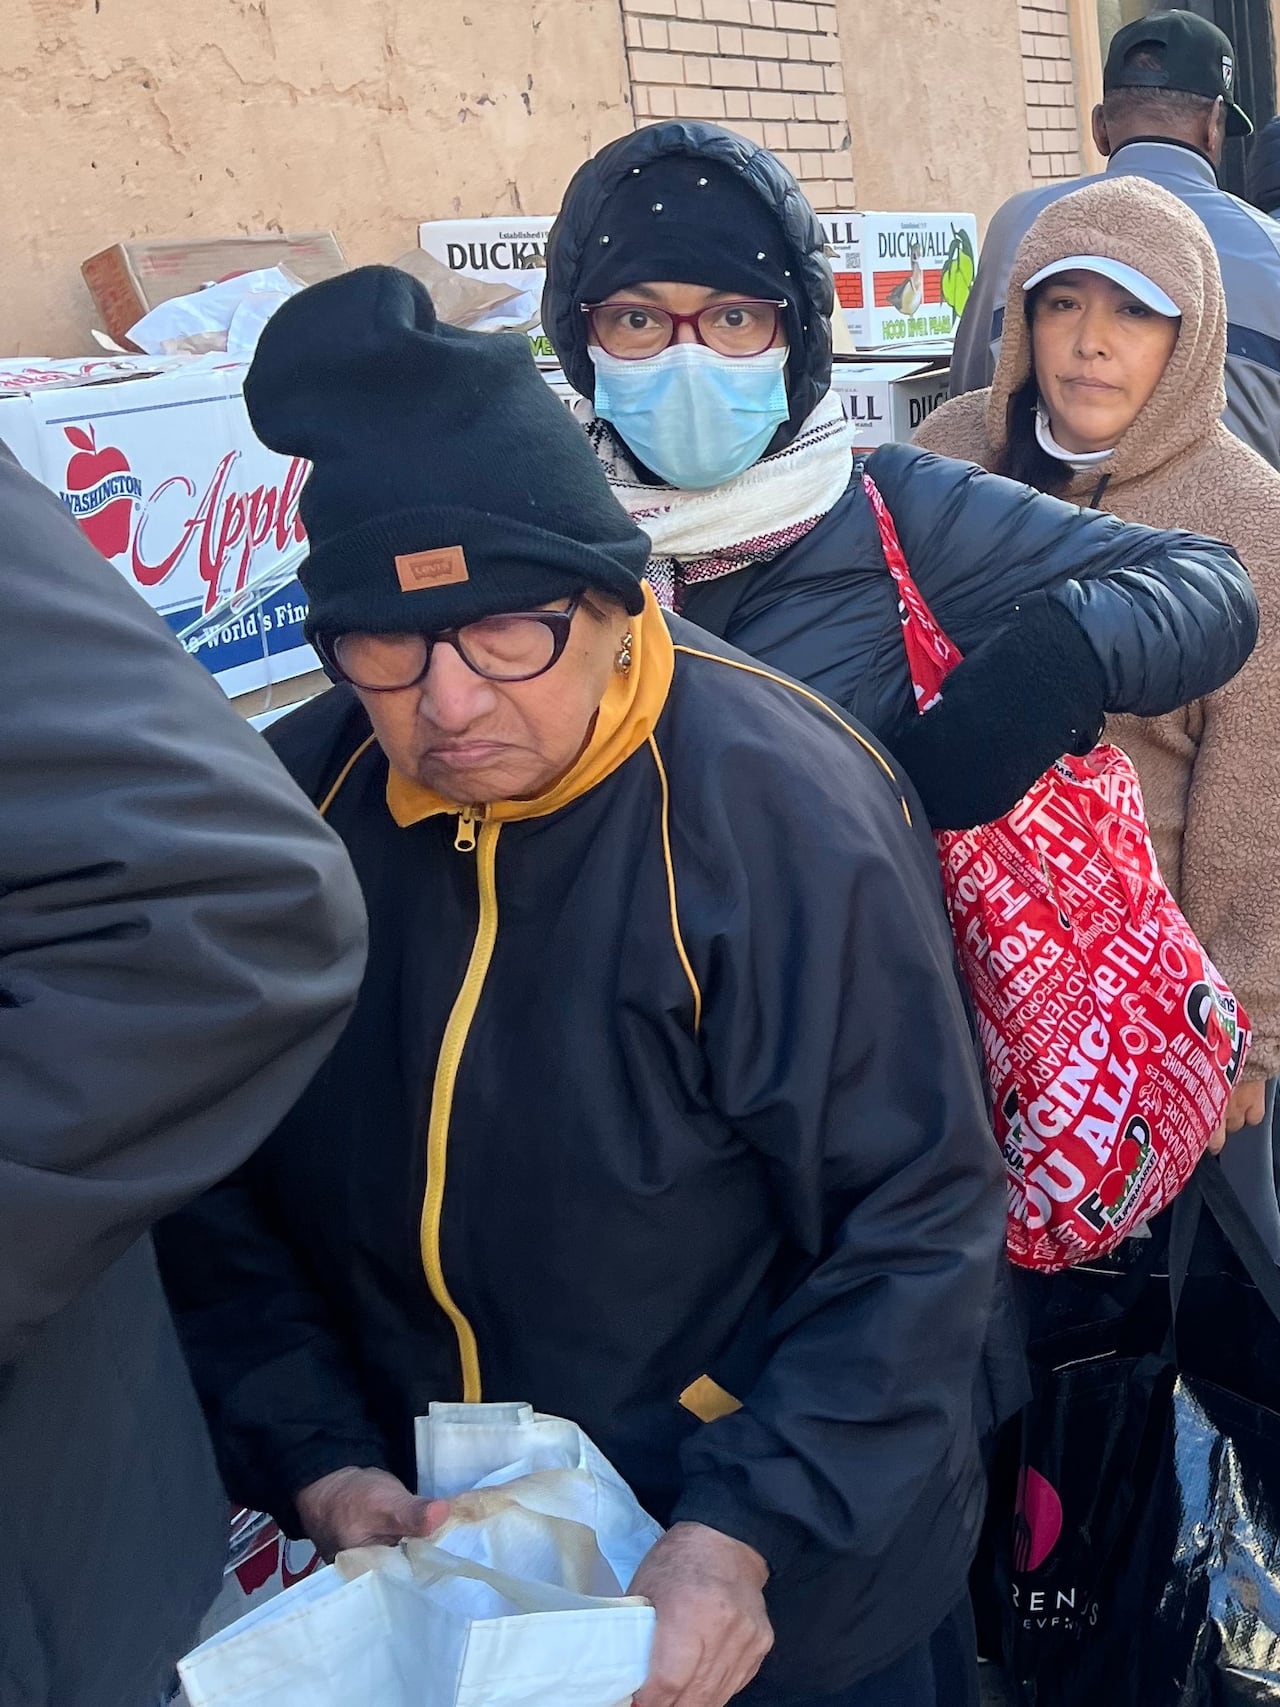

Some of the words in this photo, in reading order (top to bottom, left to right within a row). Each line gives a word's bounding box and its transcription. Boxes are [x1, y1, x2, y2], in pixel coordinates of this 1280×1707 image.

[1032, 997, 1095, 1090] CULINARY
[1161, 1051, 1198, 1096] SHOPPING
[1169, 1032, 1194, 1058] AN
[1144, 1063, 1178, 1095] PRICES
[1074, 1056, 1139, 1166] ALL
[1113, 1152, 1157, 1227] SUPERMARKET
